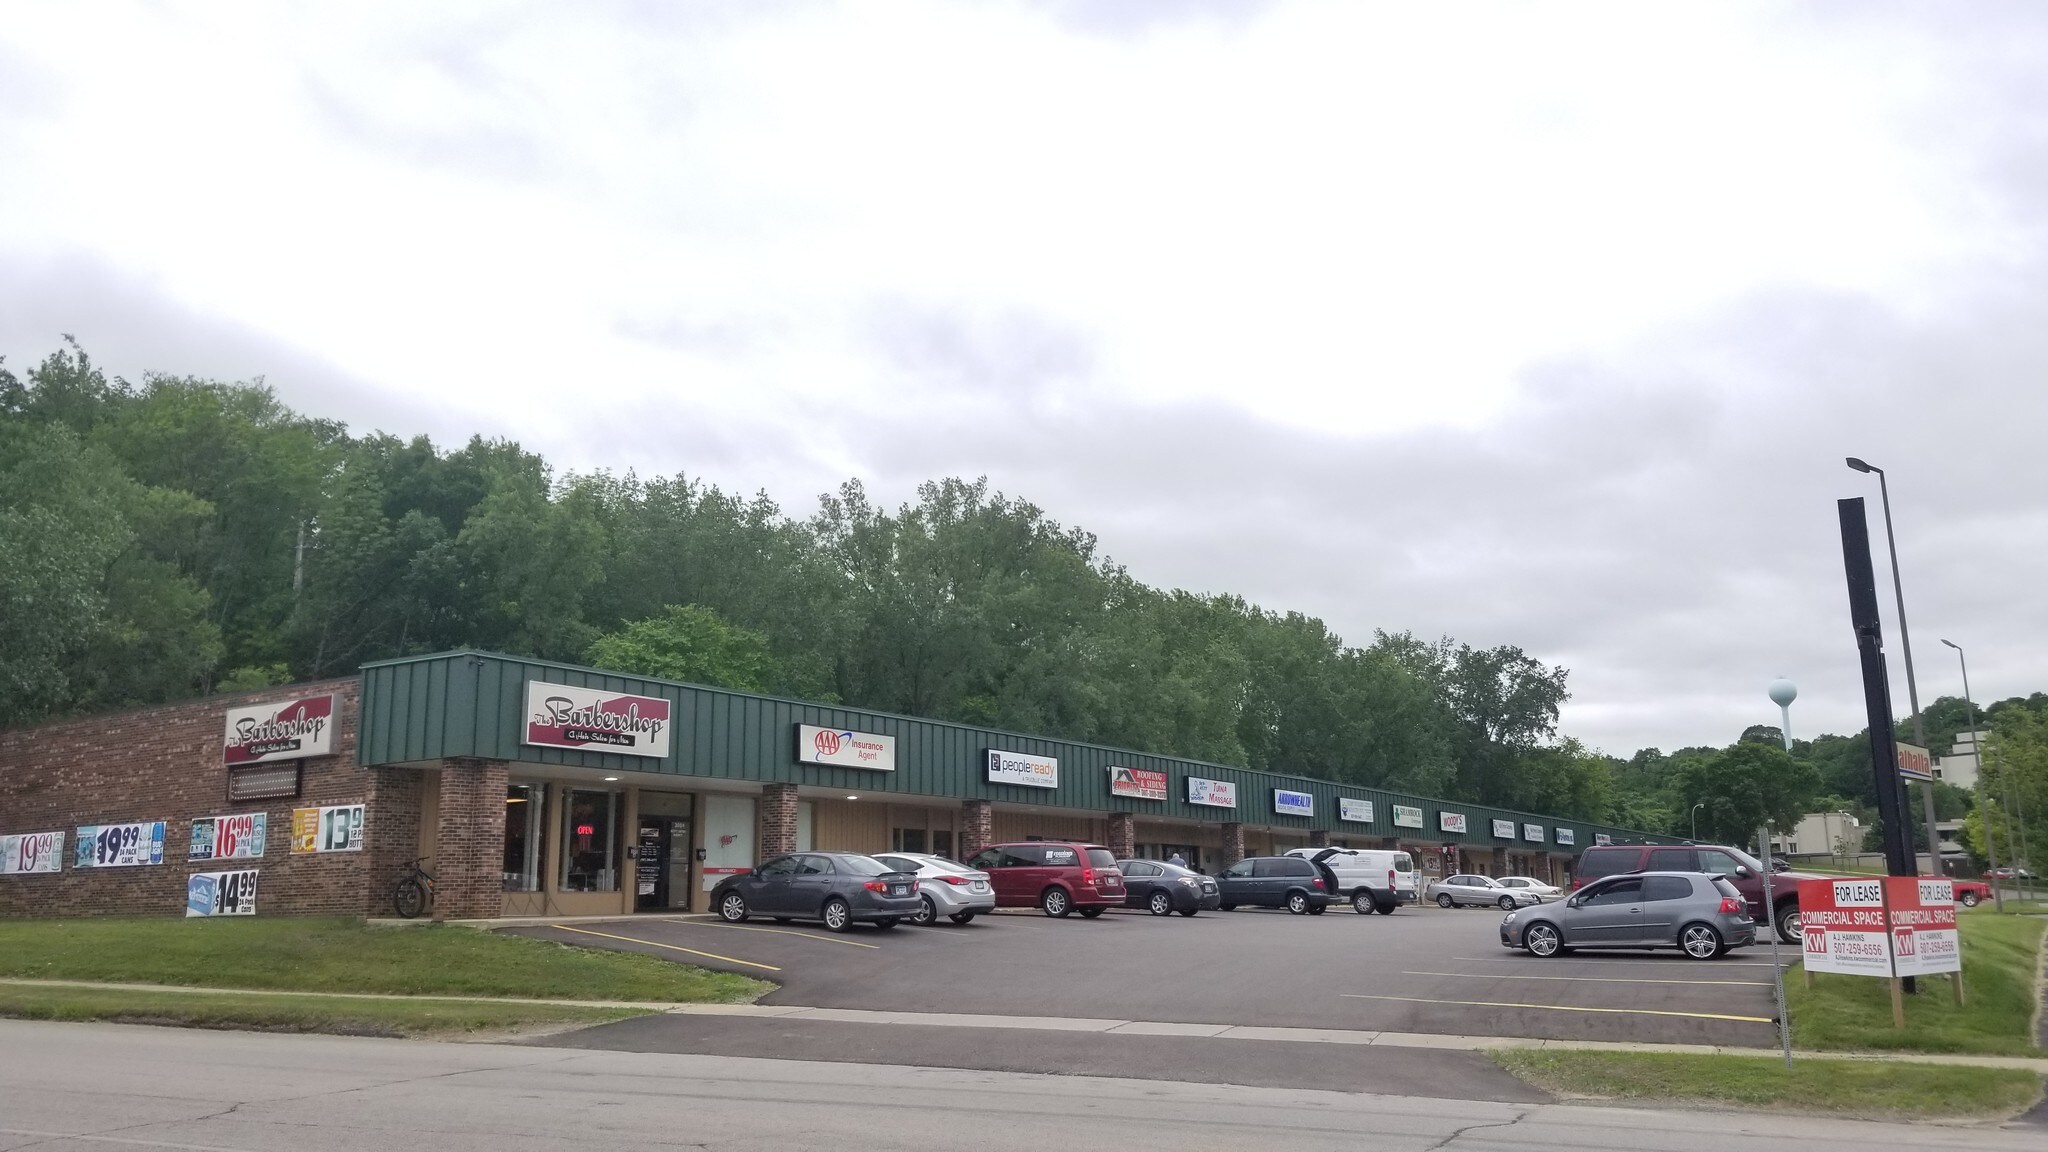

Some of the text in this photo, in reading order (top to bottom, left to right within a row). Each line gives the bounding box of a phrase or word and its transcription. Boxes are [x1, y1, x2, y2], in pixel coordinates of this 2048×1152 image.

[229, 706, 326, 748] The Barbershop
[535, 696, 664, 743] The Barbershop
[816, 731, 839, 754] AAA
[851, 739, 884, 751] Insurance
[858, 750, 878, 761] Agent
[1898, 749, 1931, 774] alhalla
[1002, 759, 1055, 779] peopleready
[1136, 770, 1163, 781] ROOFING
[1140, 779, 1146, 788] &
[1146, 780, 1167, 790] SIDING
[577, 825, 593, 835] OPEN
[126, 847, 137, 856] PACK
[121, 856, 134, 864] CANS
[1835, 885, 1881, 902] FOR LEASE
[1920, 885, 1952, 901] FOR LEASE
[1801, 911, 1884, 926] COMMERCIAL SPACE
[1890, 910, 1955, 925] COMMERCIAL SPACE
[1805, 933, 1825, 952] KW
[1842, 933, 1865, 942] HAWKINS
[1895, 934, 1914, 955] KW
[1833, 942, 1883, 956] 507-259-6556
